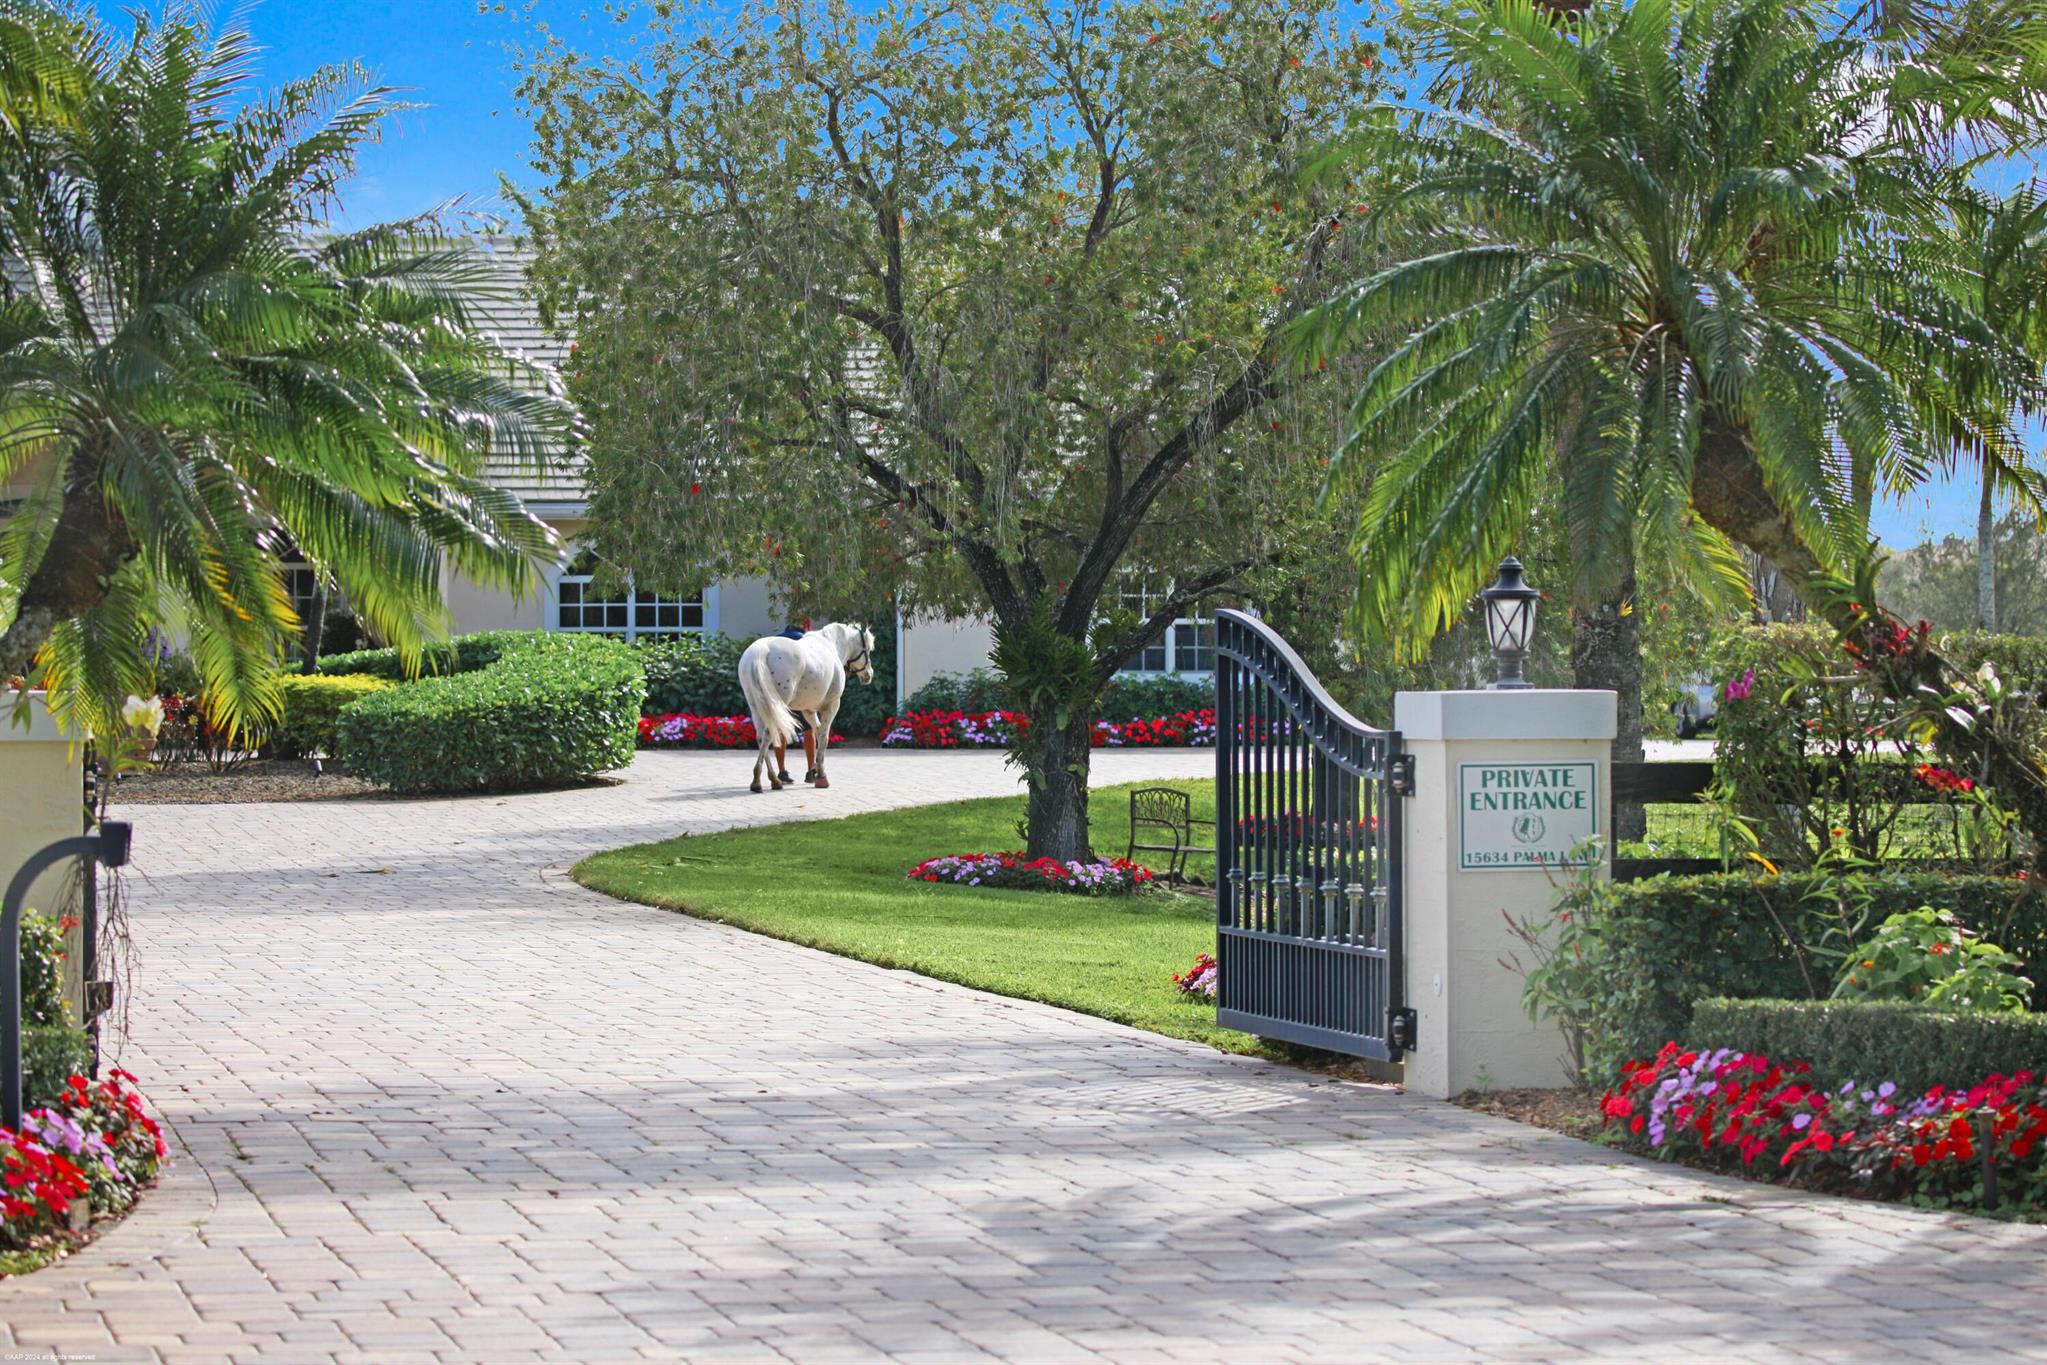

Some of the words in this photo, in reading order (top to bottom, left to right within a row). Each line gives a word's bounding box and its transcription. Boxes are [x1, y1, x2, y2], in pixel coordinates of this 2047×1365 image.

[1481, 768, 1576, 788] PRIVATE
[1470, 790, 1588, 811] ENTRANCE
[1466, 851, 1508, 864] 15634
